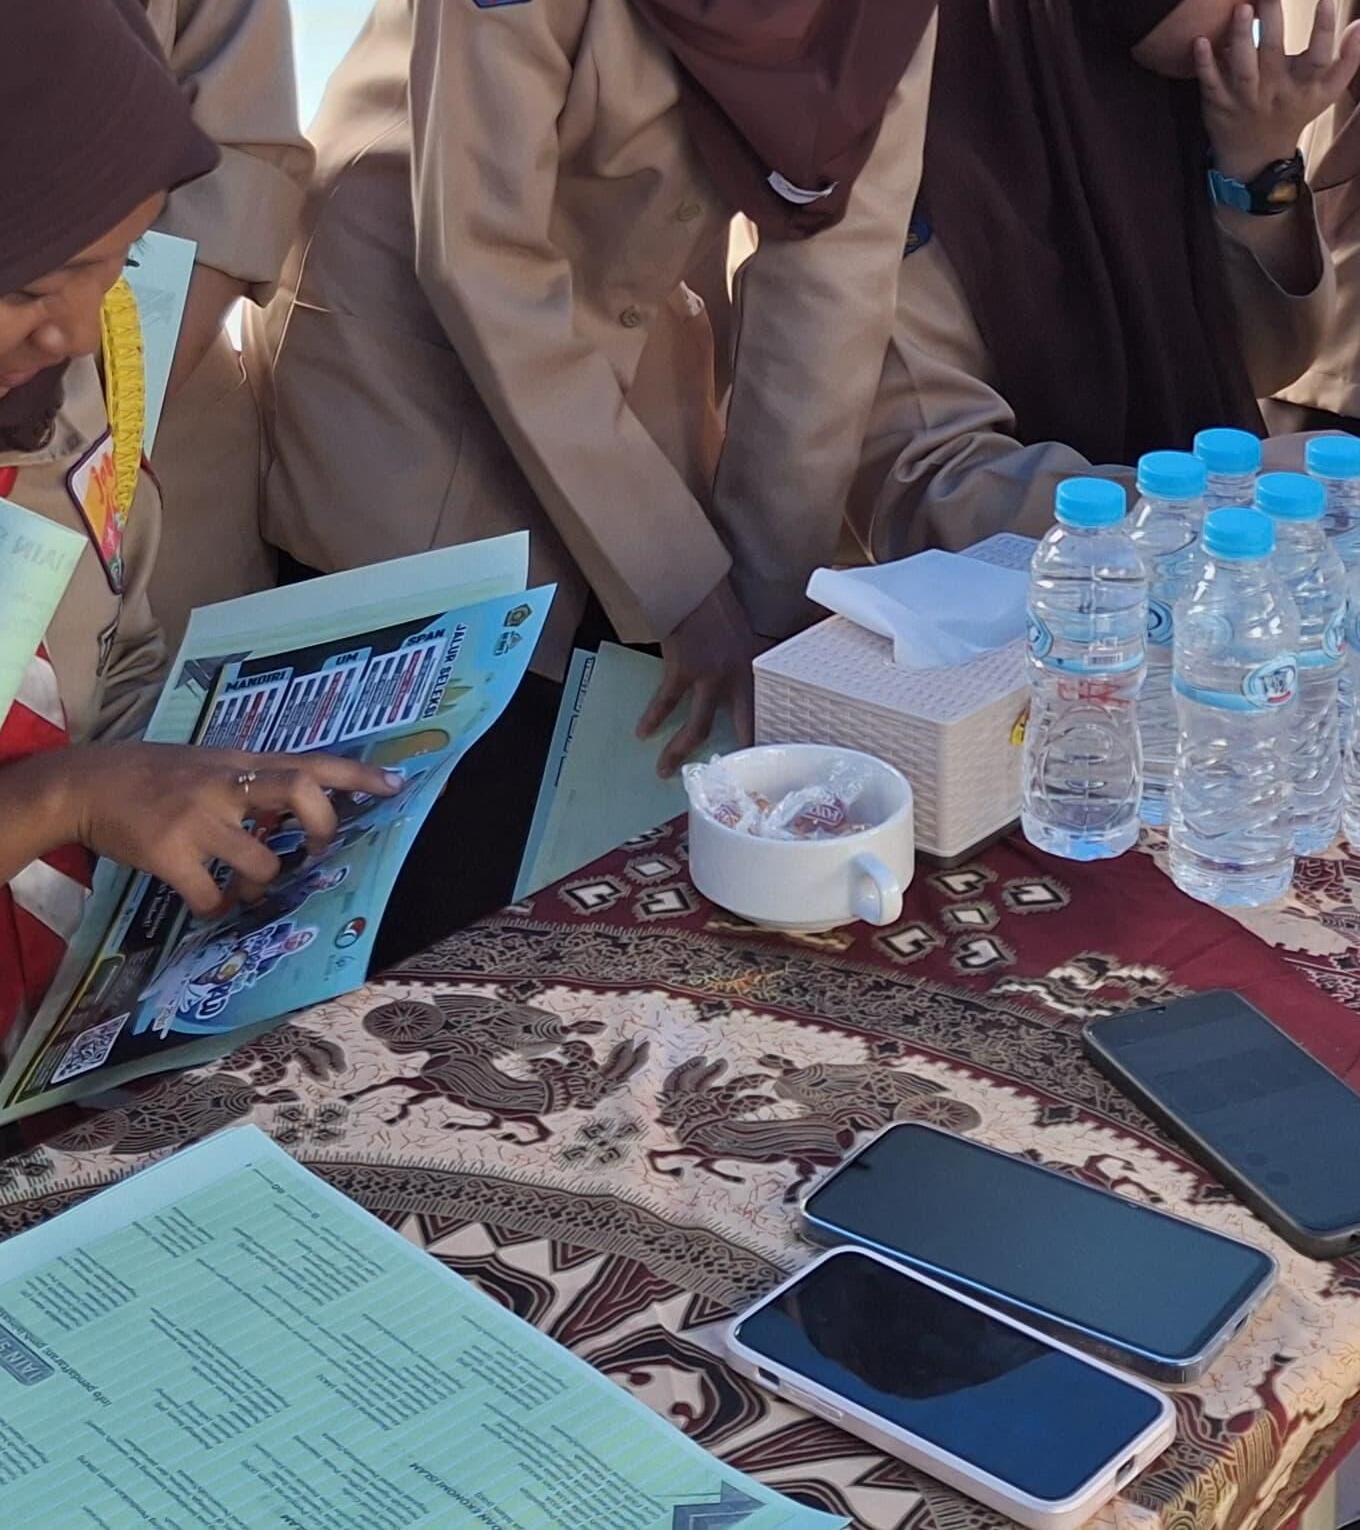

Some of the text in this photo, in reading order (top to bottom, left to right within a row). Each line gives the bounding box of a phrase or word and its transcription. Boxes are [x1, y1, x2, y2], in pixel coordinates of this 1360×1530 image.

[225, 669, 288, 693] MANDIRI
[405, 628, 446, 648] SPAN
[444, 623, 467, 665] JALUR
[6, 1349, 44, 1380] IAIN
[43, 1346, 99, 1394] pendaftaran:
[436, 1480, 481, 1514] EKONOMI
